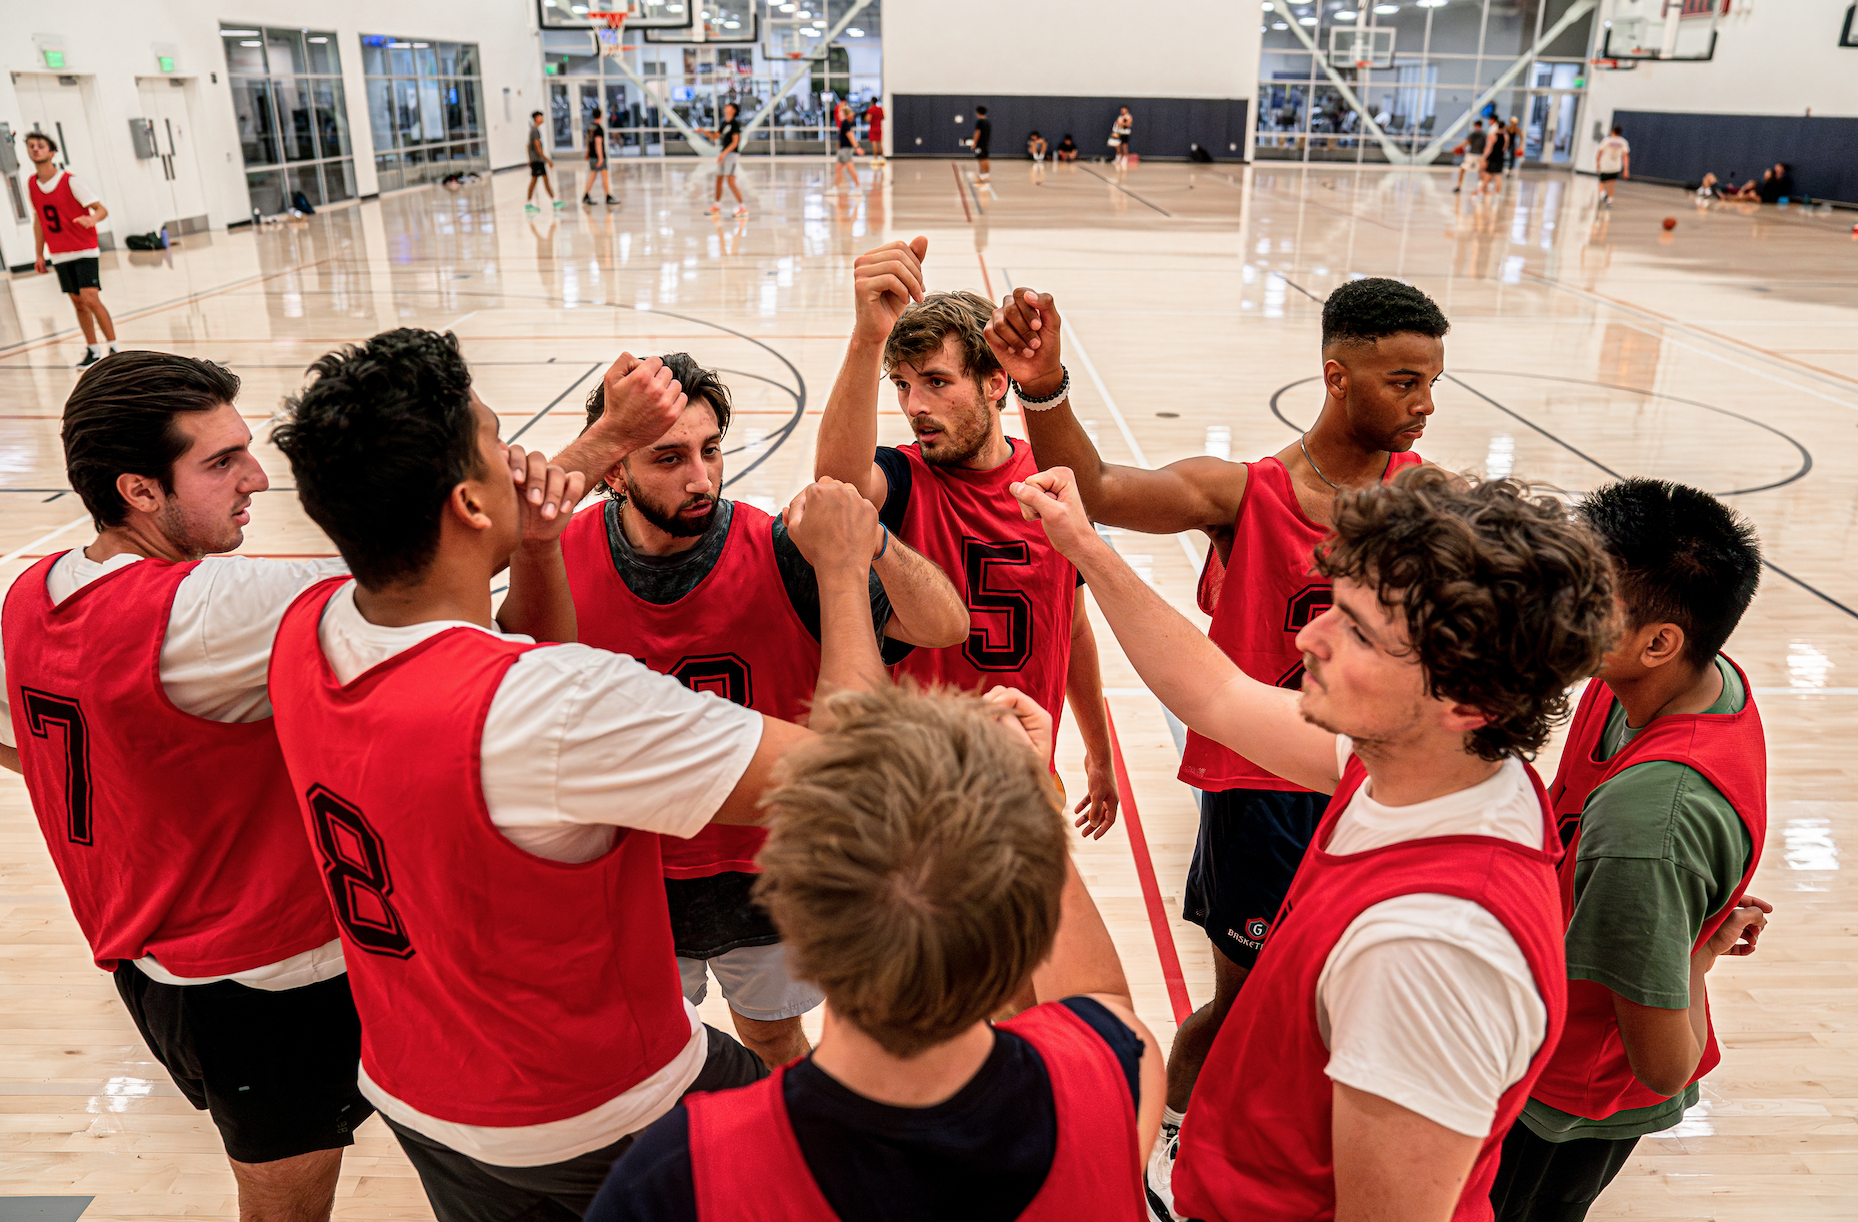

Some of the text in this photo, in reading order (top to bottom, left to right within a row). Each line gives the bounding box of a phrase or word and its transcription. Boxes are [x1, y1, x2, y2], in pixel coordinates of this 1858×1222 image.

[43, 204, 61, 233] 9
[961, 535, 1034, 672] 5
[20, 685, 93, 847] 7
[306, 782, 416, 960] 8
[1252, 923, 1263, 936] G
